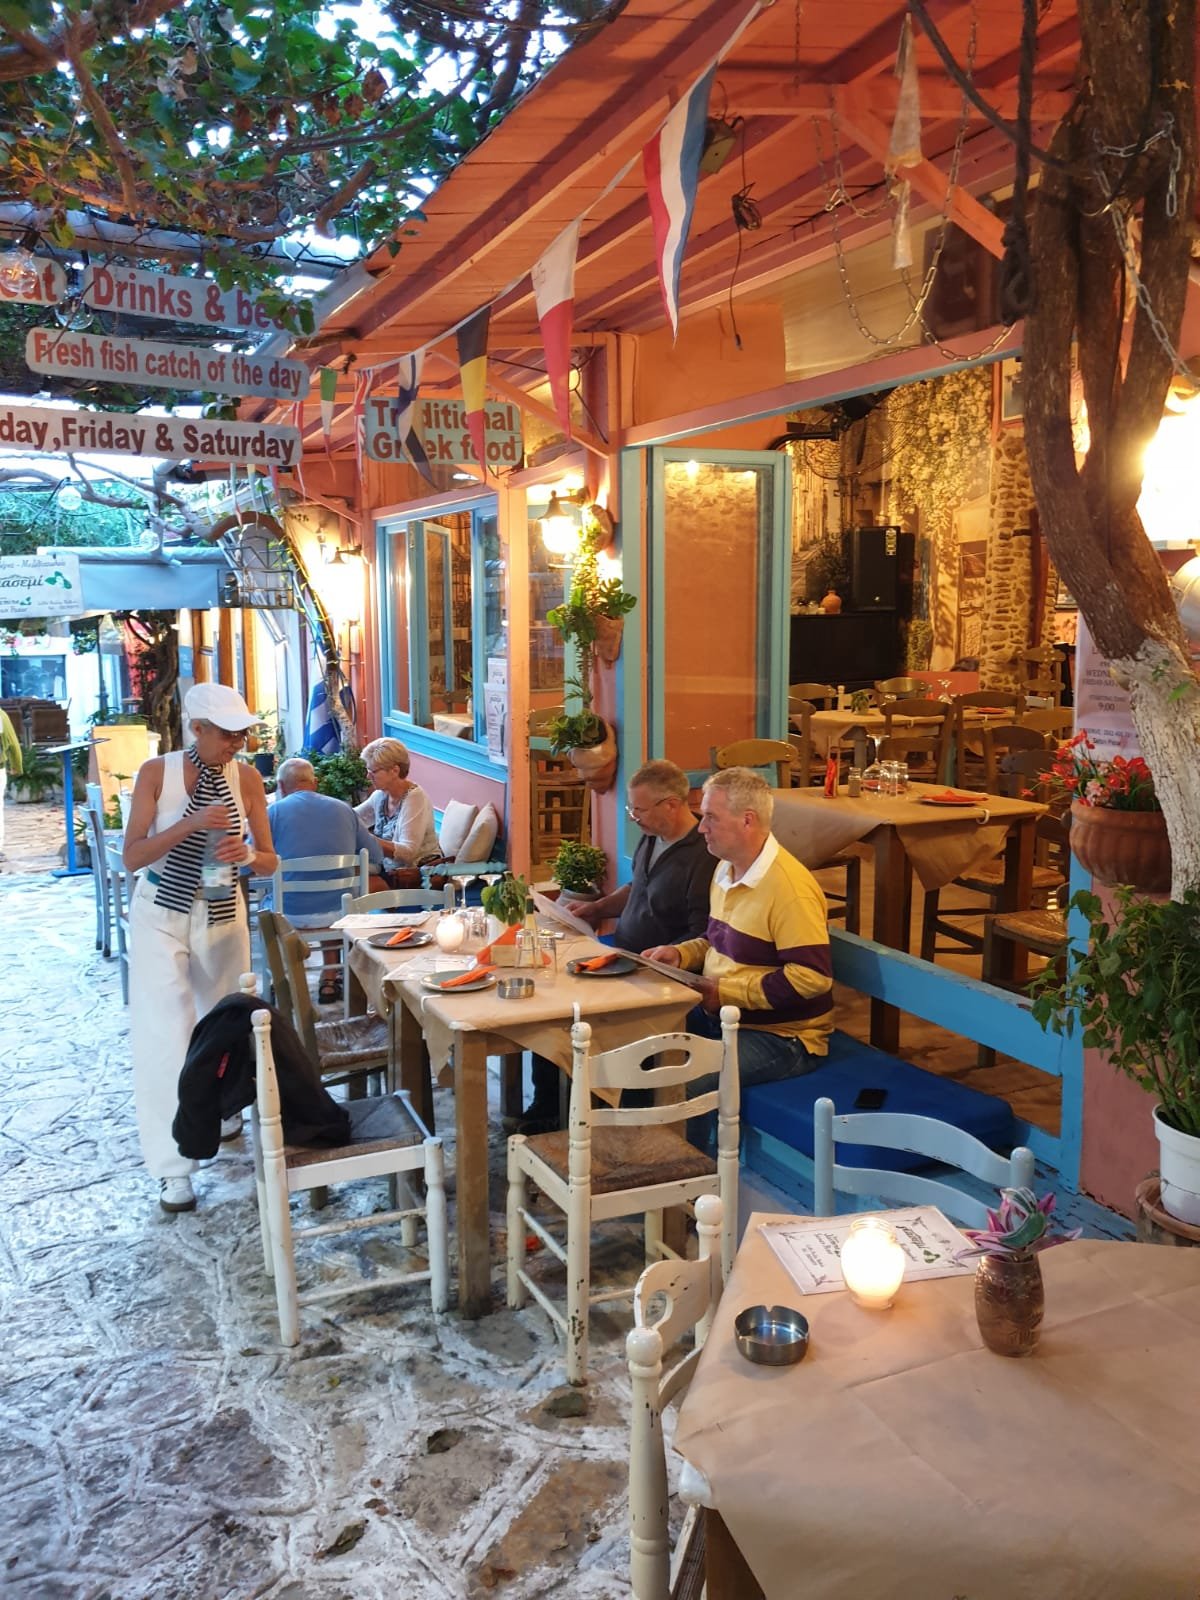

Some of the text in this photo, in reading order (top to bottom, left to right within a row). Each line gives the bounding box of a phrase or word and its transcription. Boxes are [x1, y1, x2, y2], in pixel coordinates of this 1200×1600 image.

[92, 267, 193, 319] Drinks
[205, 285, 226, 322] &
[34, 333, 302, 397] Fresh fish catch of the day
[155, 423, 174, 452] &
[183, 425, 295, 466] Saturday
